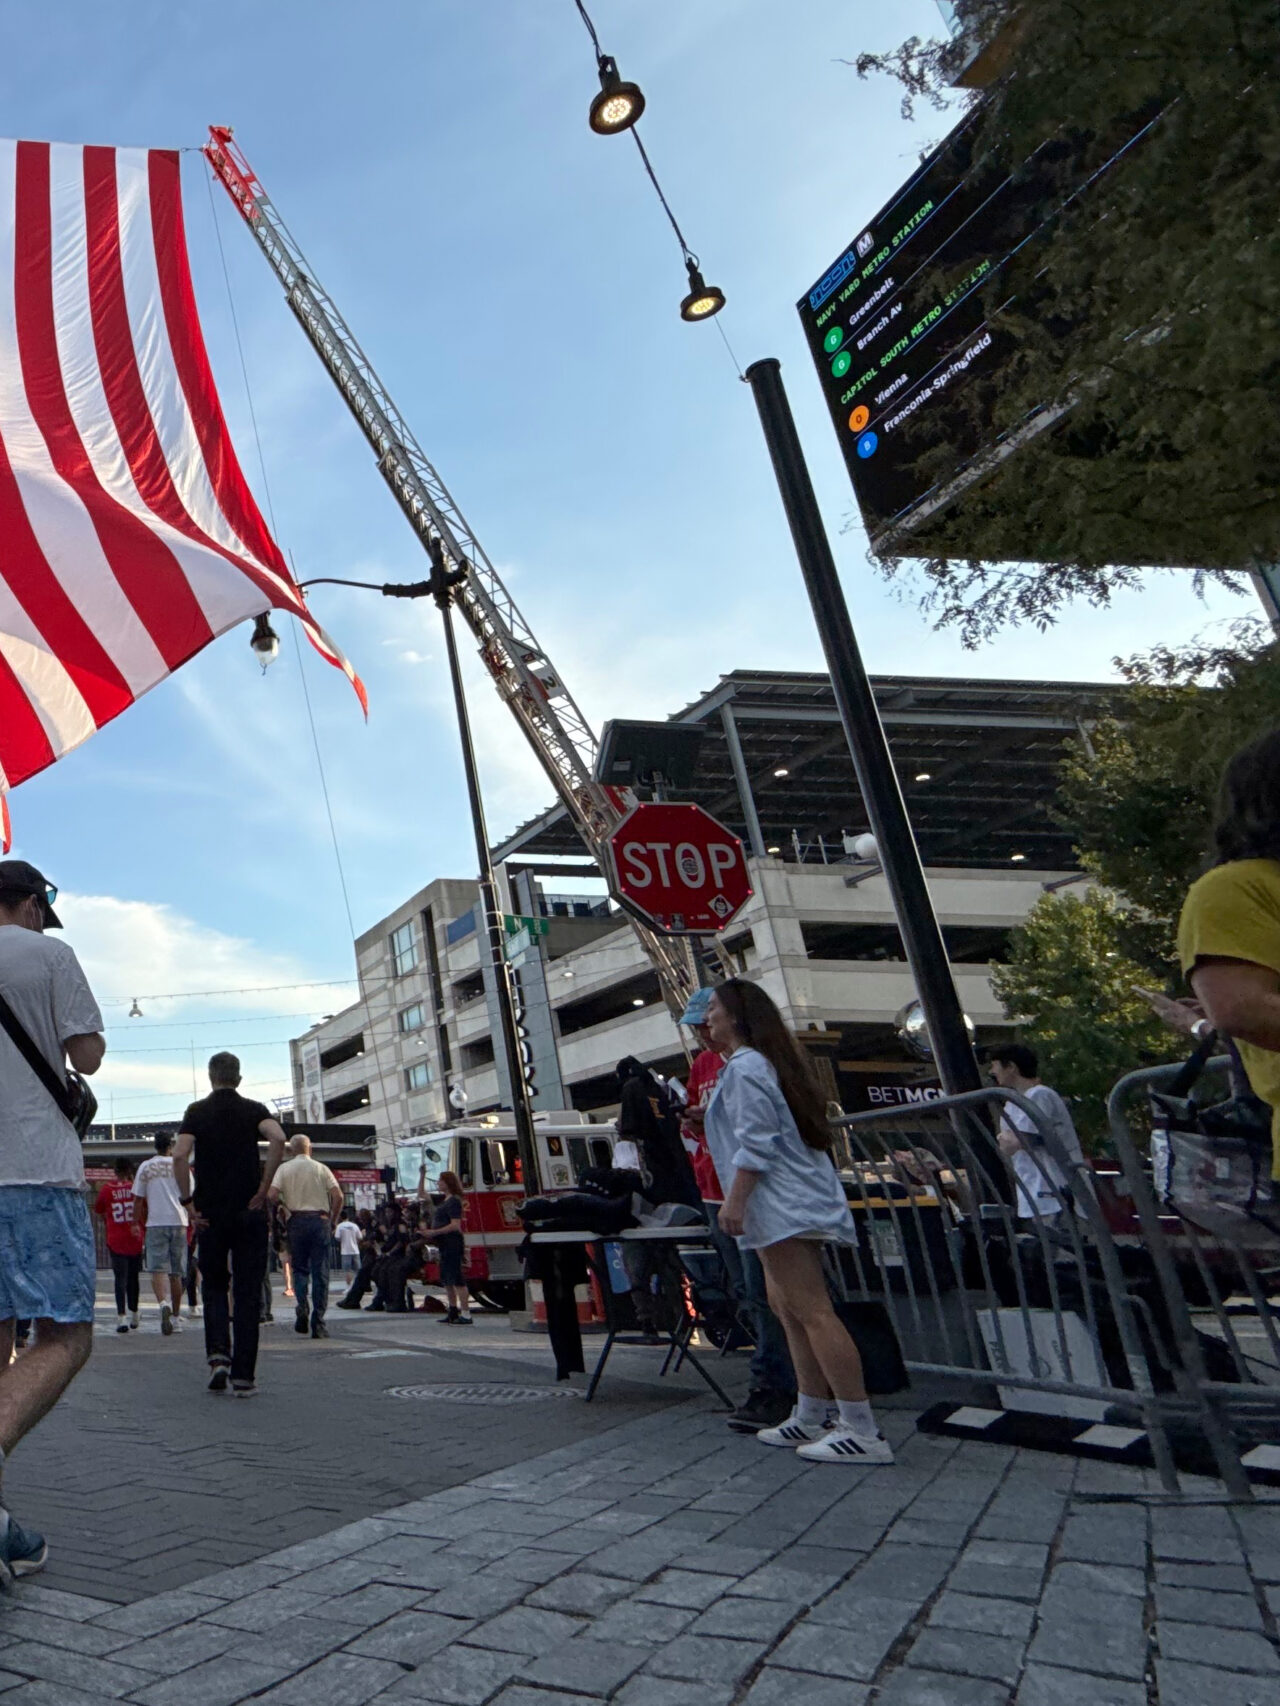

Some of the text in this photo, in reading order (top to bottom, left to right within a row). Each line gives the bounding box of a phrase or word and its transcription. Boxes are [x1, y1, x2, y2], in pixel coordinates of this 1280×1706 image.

[816, 302, 837, 327] NAVY
[838, 278, 860, 302] YARD
[862, 246, 890, 279] METRO
[892, 200, 933, 246] STATION
[849, 277, 895, 326] Greenbelt
[856, 315, 889, 350] Branch
[890, 302, 903, 319] Av
[840, 367, 879, 405] CAPITOL
[880, 336, 909, 368] SOUTH
[910, 305, 942, 337] METRO
[874, 372, 909, 405] Vienna
[884, 333, 992, 432] Franconia-Springfield
[623, 842, 736, 889] STOP
[111, 1202, 134, 1223] 22
